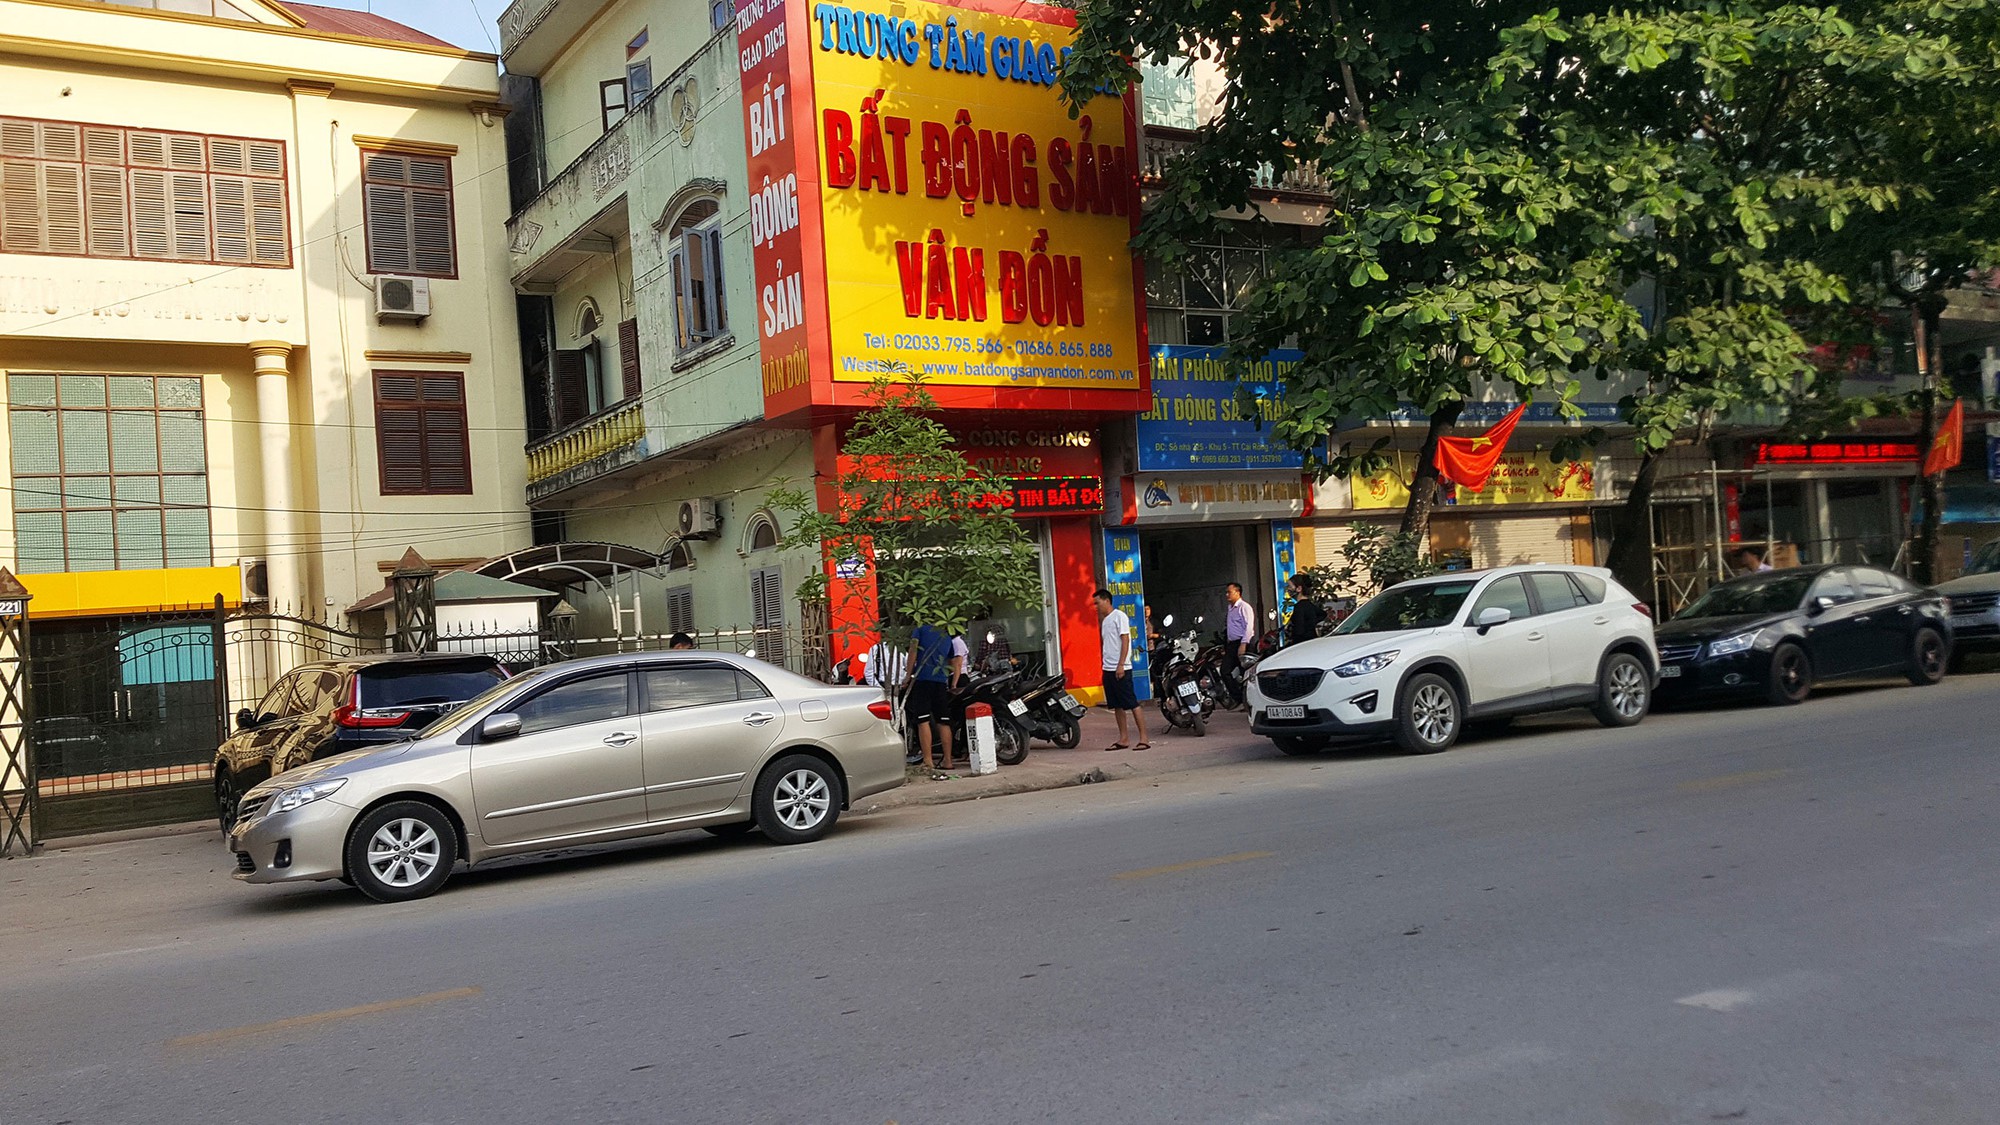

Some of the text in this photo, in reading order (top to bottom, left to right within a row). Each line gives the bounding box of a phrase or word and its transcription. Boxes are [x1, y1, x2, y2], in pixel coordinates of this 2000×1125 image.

[741, 22, 786, 72] GIAO DỊCH
[815, 3, 920, 64] TRUNG
[924, 14, 987, 75] TÂM
[991, 35, 1057, 86] GIAO
[749, 72, 785, 157] BẤT
[823, 89, 1129, 217] BẤT ĐỘNG SẢN
[750, 173, 799, 249] ĐỘNG
[762, 258, 803, 338] SẢN
[895, 229, 1085, 327] VÂN ĐỒN
[762, 341, 809, 397] VÂN ĐỒN
[863, 332, 891, 349] Tel:
[893, 334, 1003, 354] 02033.795.566
[921, 360, 1135, 382] www.batdongsanvandon.com.vn
[968, 425, 1021, 447] CÔNG
[1025, 424, 1092, 447] CHỨNG
[1174, 393, 1217, 426] ĐỘNG
[1017, 489, 1044, 507] TIN
[1047, 481, 1078, 506] BẤT
